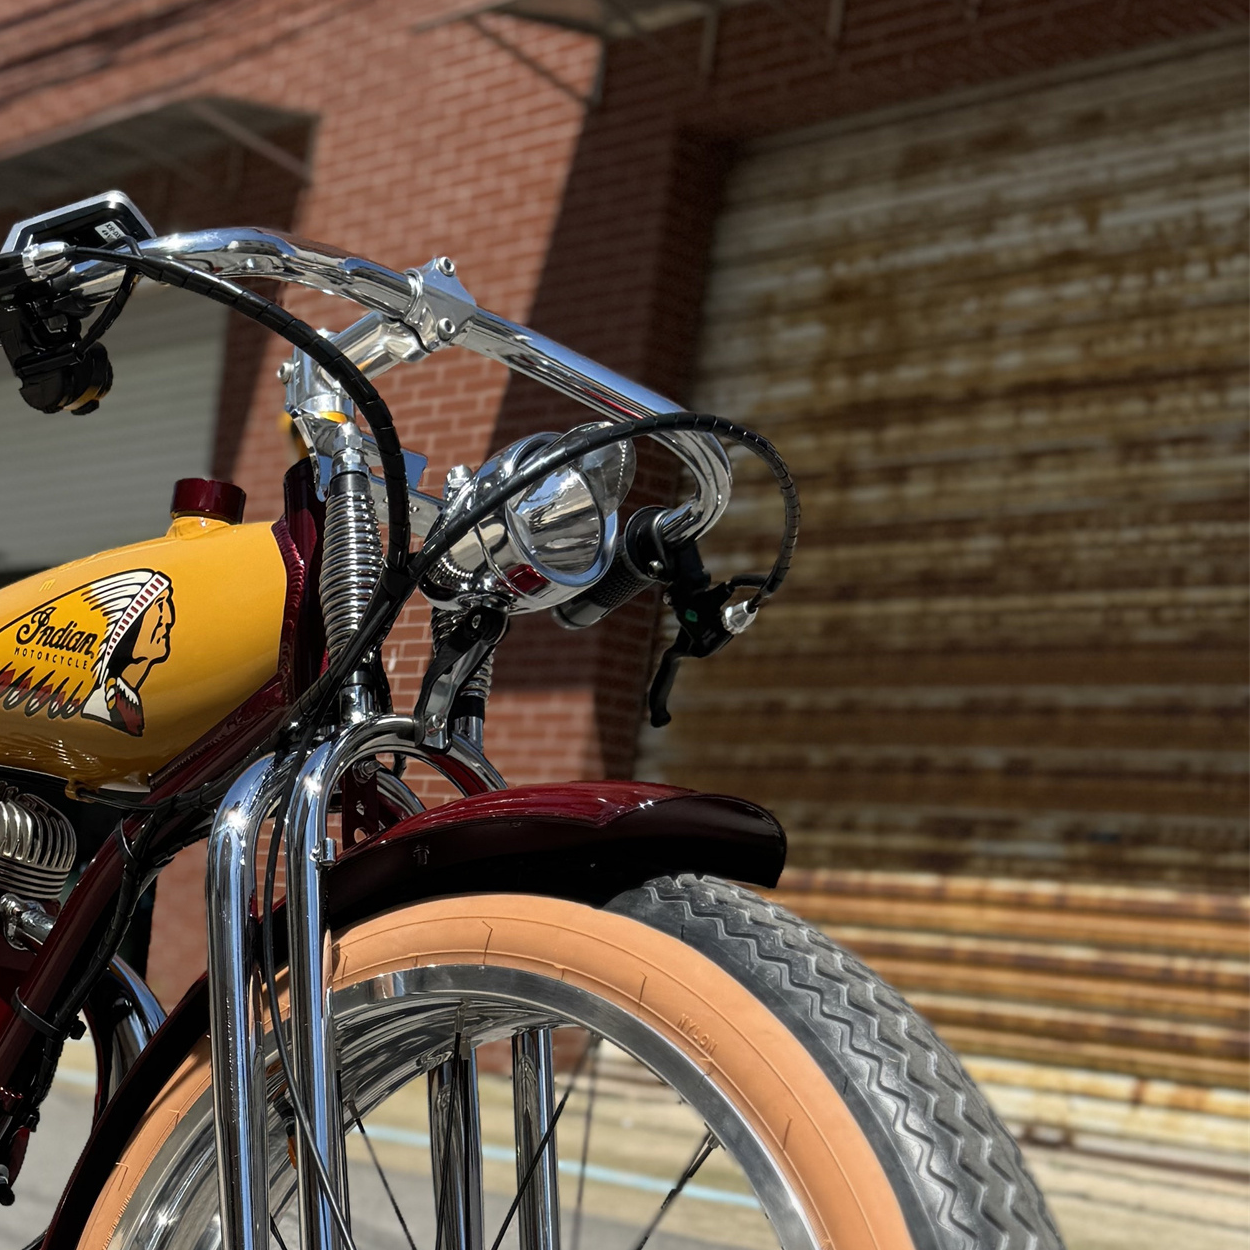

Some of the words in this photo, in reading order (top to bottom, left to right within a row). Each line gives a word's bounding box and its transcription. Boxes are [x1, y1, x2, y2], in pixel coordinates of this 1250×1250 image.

[16, 606, 98, 659] Indian
[14, 647, 87, 670] MOTORCYCLE
[677, 1013, 719, 1057] NYLON
